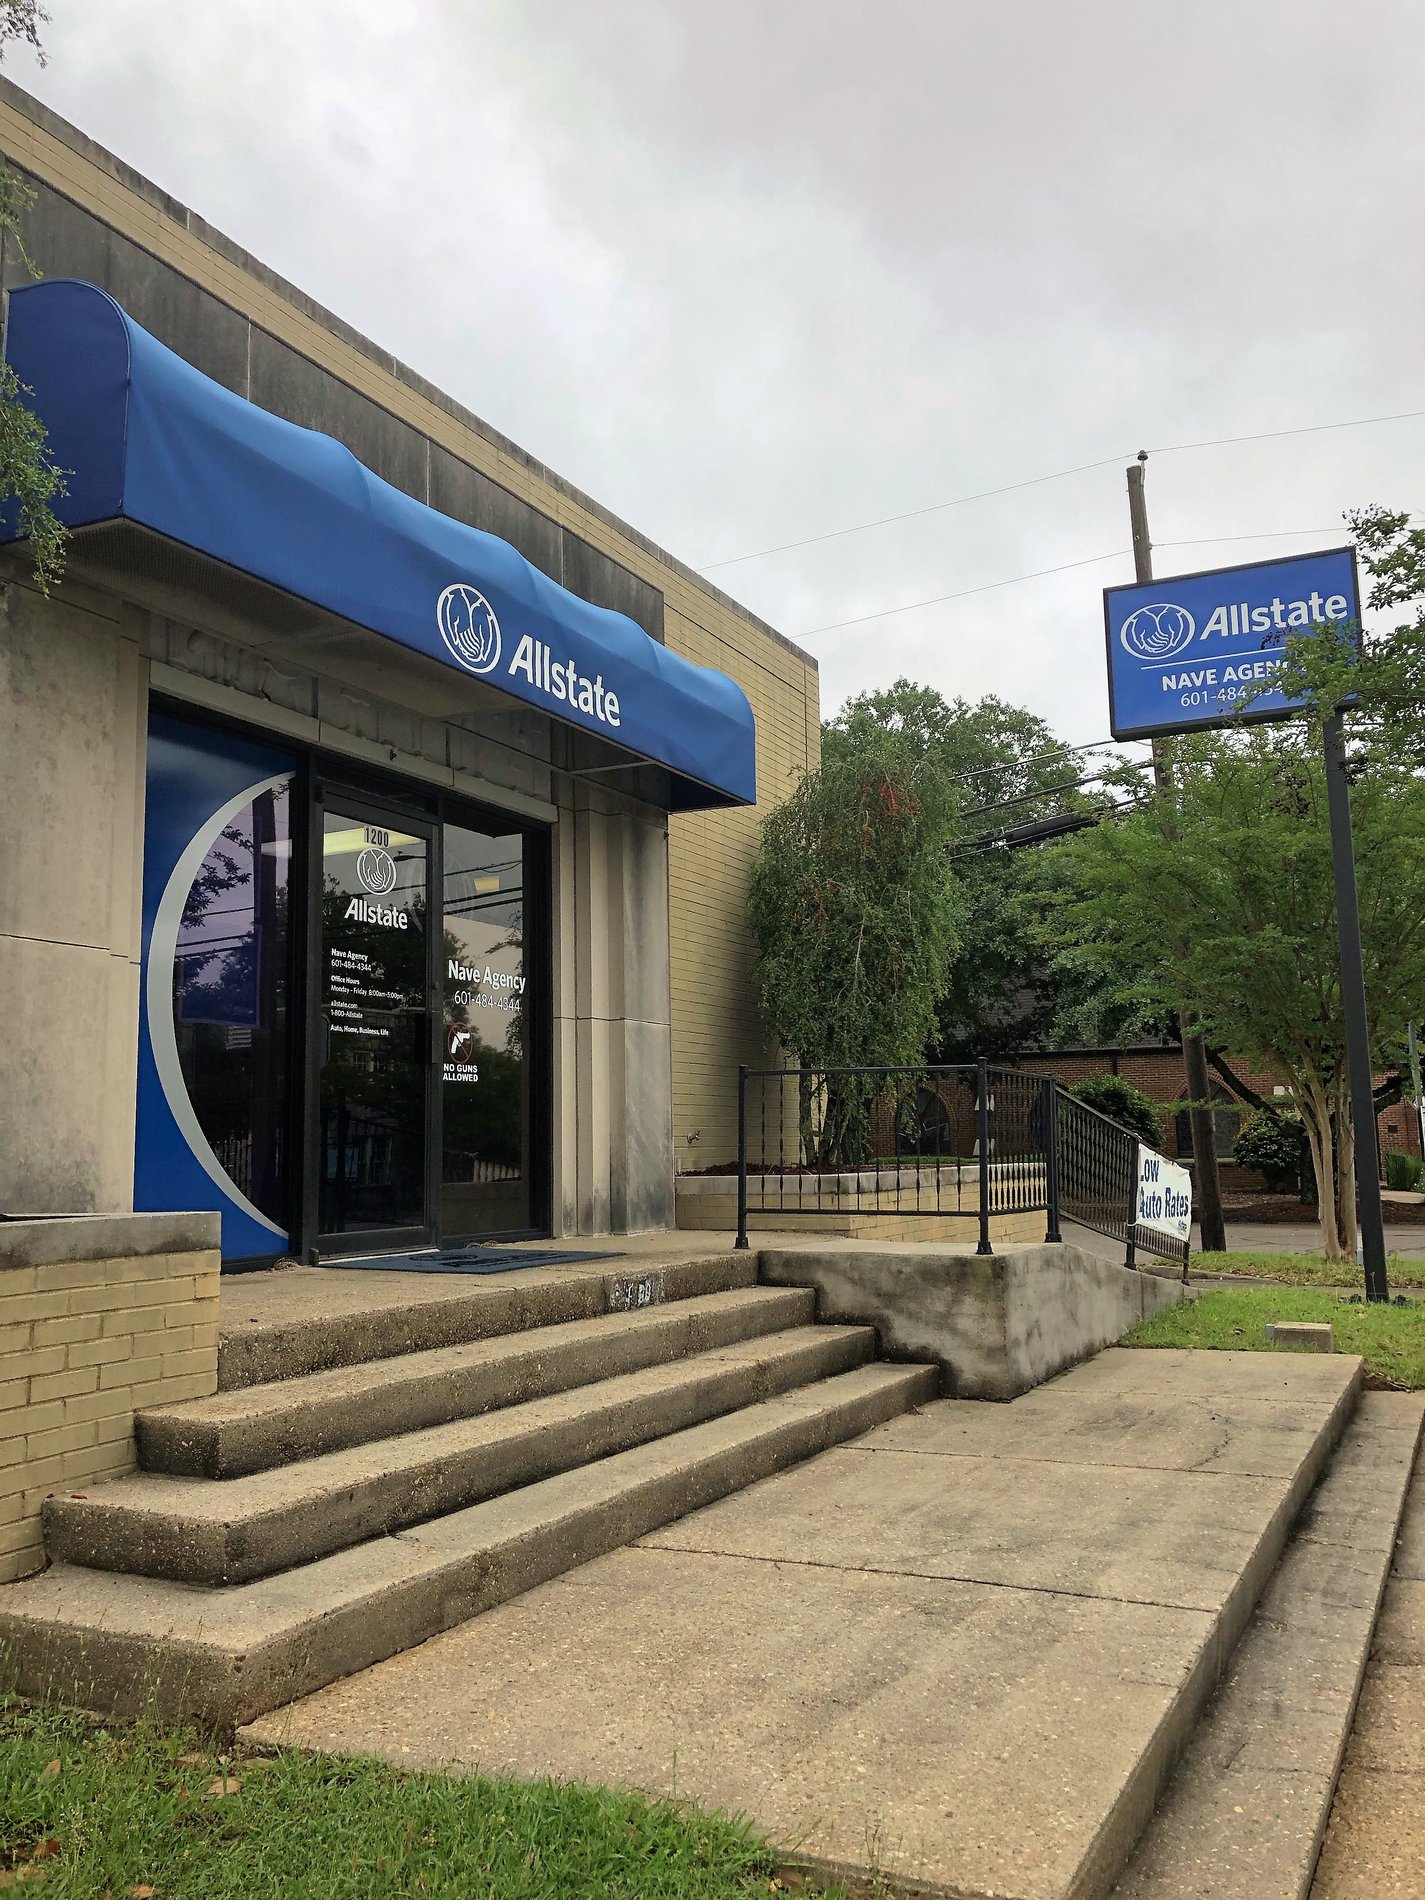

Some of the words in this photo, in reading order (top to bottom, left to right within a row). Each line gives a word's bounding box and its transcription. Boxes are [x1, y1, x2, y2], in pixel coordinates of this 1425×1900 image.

[1199, 591, 1348, 641] Allstate
[507, 634, 621, 727] Allstate
[1162, 668, 1218, 692] NAVE
[1222, 659, 1304, 683] AGEN
[365, 826, 389, 848] 1200
[344, 898, 408, 930] Allstate
[331, 947, 347, 958] Nave
[347, 950, 368, 962] Agency
[331, 959, 372, 971] 601-484-4344
[331, 975, 345, 983] Office
[346, 977, 360, 985] Hours
[448, 959, 481, 983] Nave
[483, 966, 526, 994] Agency
[331, 985, 350, 994] Monday
[353, 987, 367, 996] Friday
[331, 1000, 358, 1009] allstate.com
[454, 990, 521, 1012] 601-484-4344
[331, 1009, 363, 1018] 1-800-Allstate
[330, 1024, 343, 1032] Auto,
[344, 1025, 359, 1034] Home,
[359, 1026, 380, 1036] Business,
[380, 1028, 389, 1036] Life
[442, 1072, 479, 1082] ALLOWED
[443, 1063, 455, 1072] NO
[456, 1064, 478, 1073] GUNS
[1140, 1159, 1160, 1182] ow
[1165, 1187, 1189, 1218] Rates
